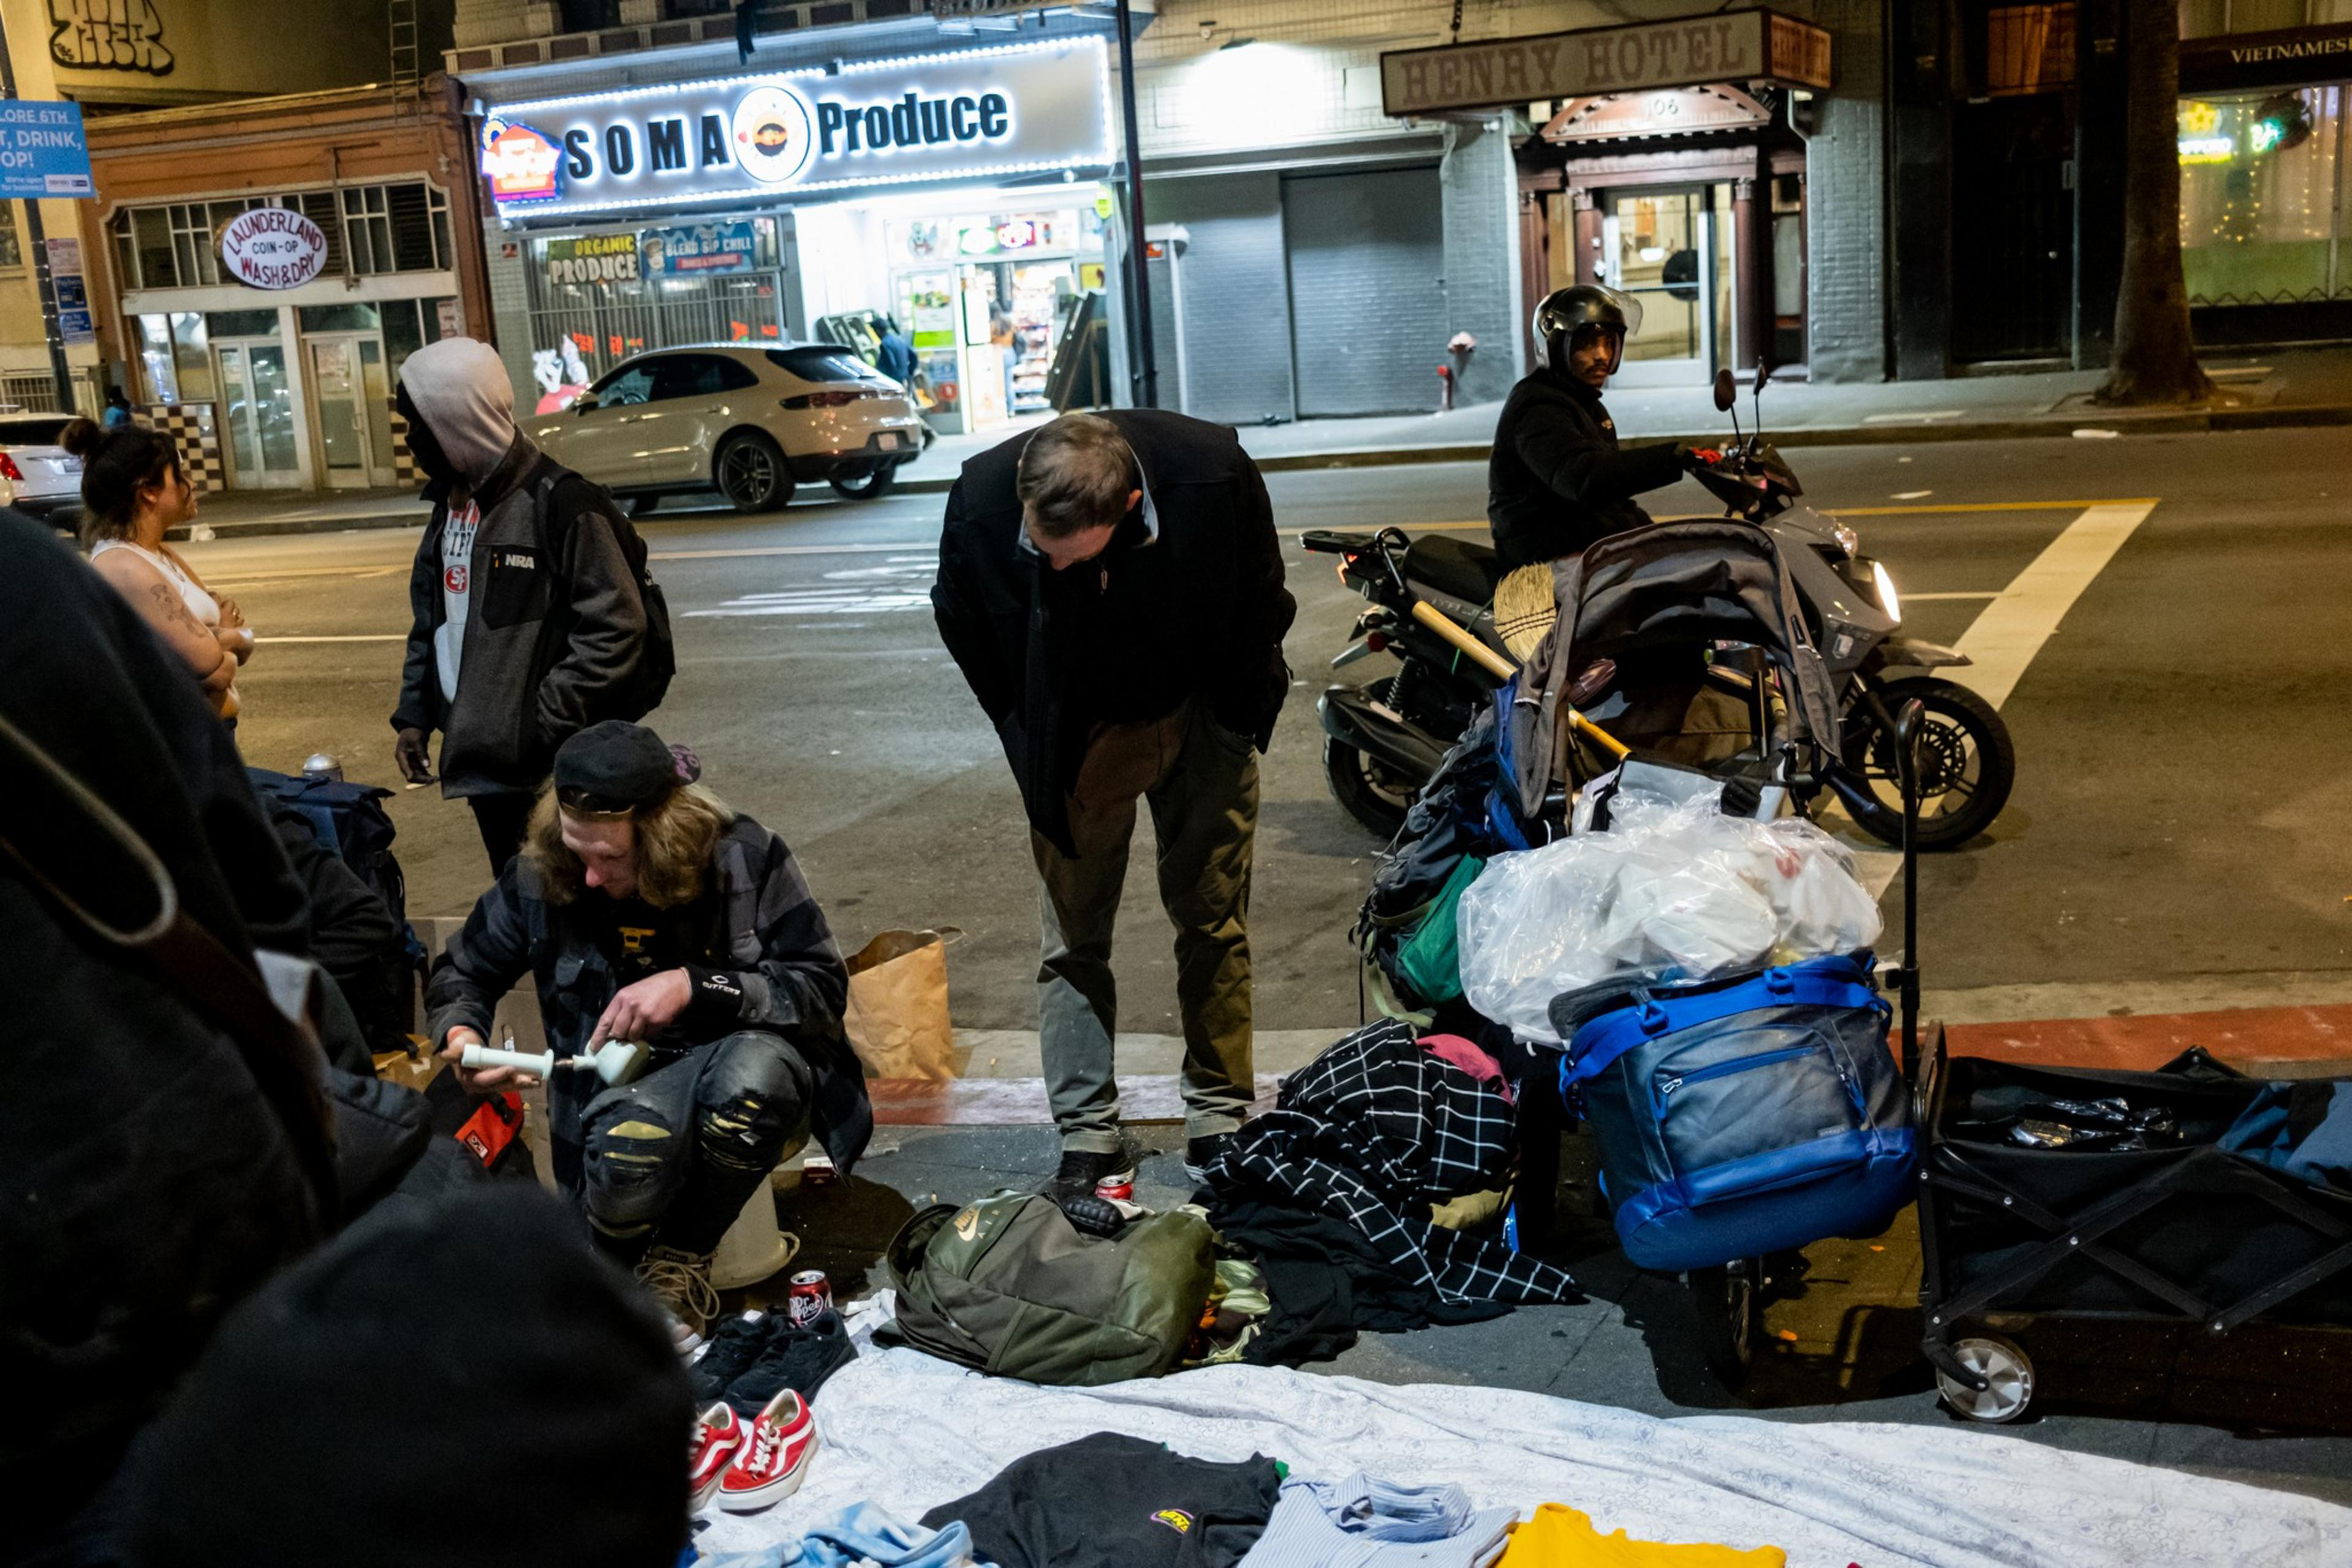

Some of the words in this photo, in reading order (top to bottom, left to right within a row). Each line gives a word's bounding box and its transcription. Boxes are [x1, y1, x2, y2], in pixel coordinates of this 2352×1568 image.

[2232, 38, 2352, 62] VIETNAMES
[1401, 42, 1561, 105] HENRY
[1583, 22, 1745, 86] HOTEL
[40, 110, 68, 124] 6TH
[1648, 98, 1679, 117] 106
[17, 130, 82, 151] DRINK,
[565, 114, 730, 179] SOMA
[817, 92, 1008, 154] Produce
[1, 151, 34, 167] OP!
[226, 212, 323, 255] LAUNDERLAND
[575, 235, 635, 256] ORGANIC
[551, 254, 637, 284] PRODUCE
[505, 553, 535, 570] NRA
